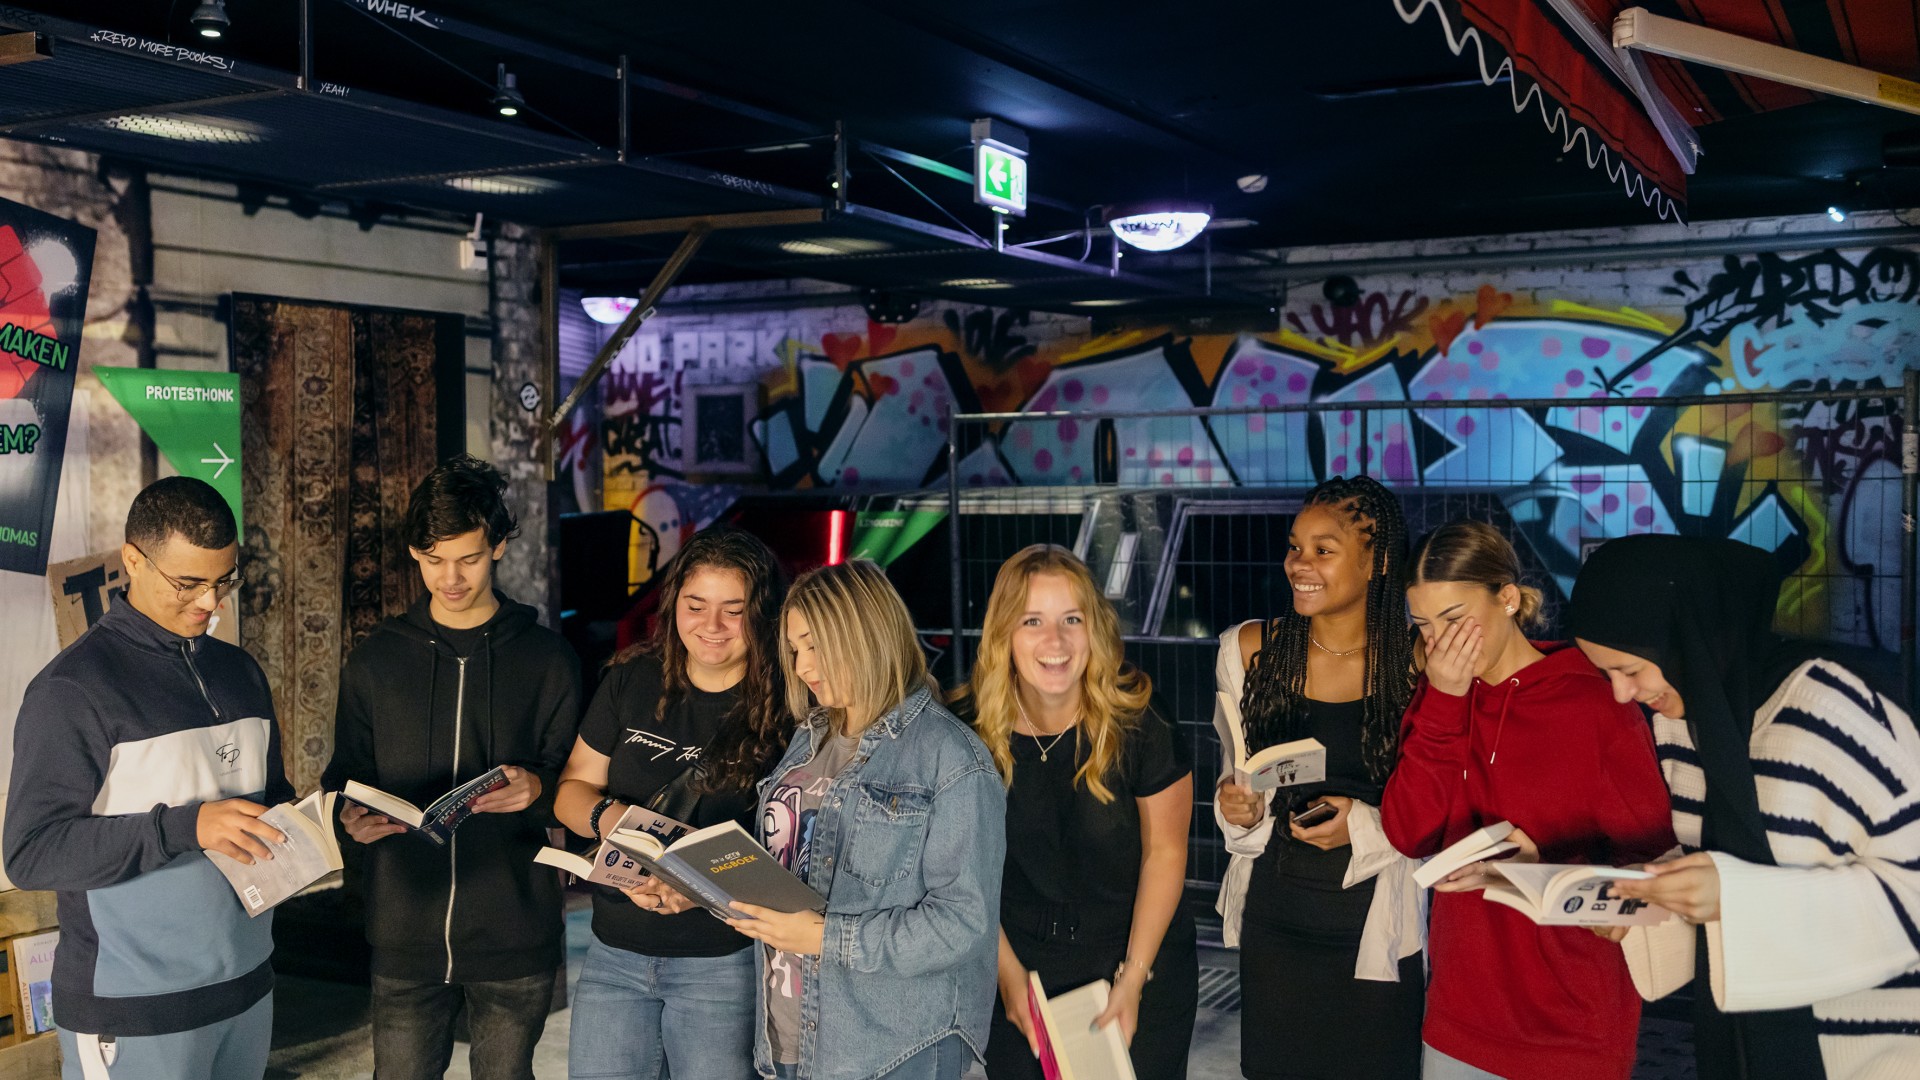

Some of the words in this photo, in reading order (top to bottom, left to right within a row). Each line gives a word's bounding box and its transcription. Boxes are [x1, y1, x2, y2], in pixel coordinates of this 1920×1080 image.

[139, 39, 176, 57] MORE
[320, 82, 350, 97] YEAH!
[146, 385, 234, 402] PROTESTHONK
[625, 727, 677, 761] Tommy
[710, 854, 758, 874] DAGBOEK
